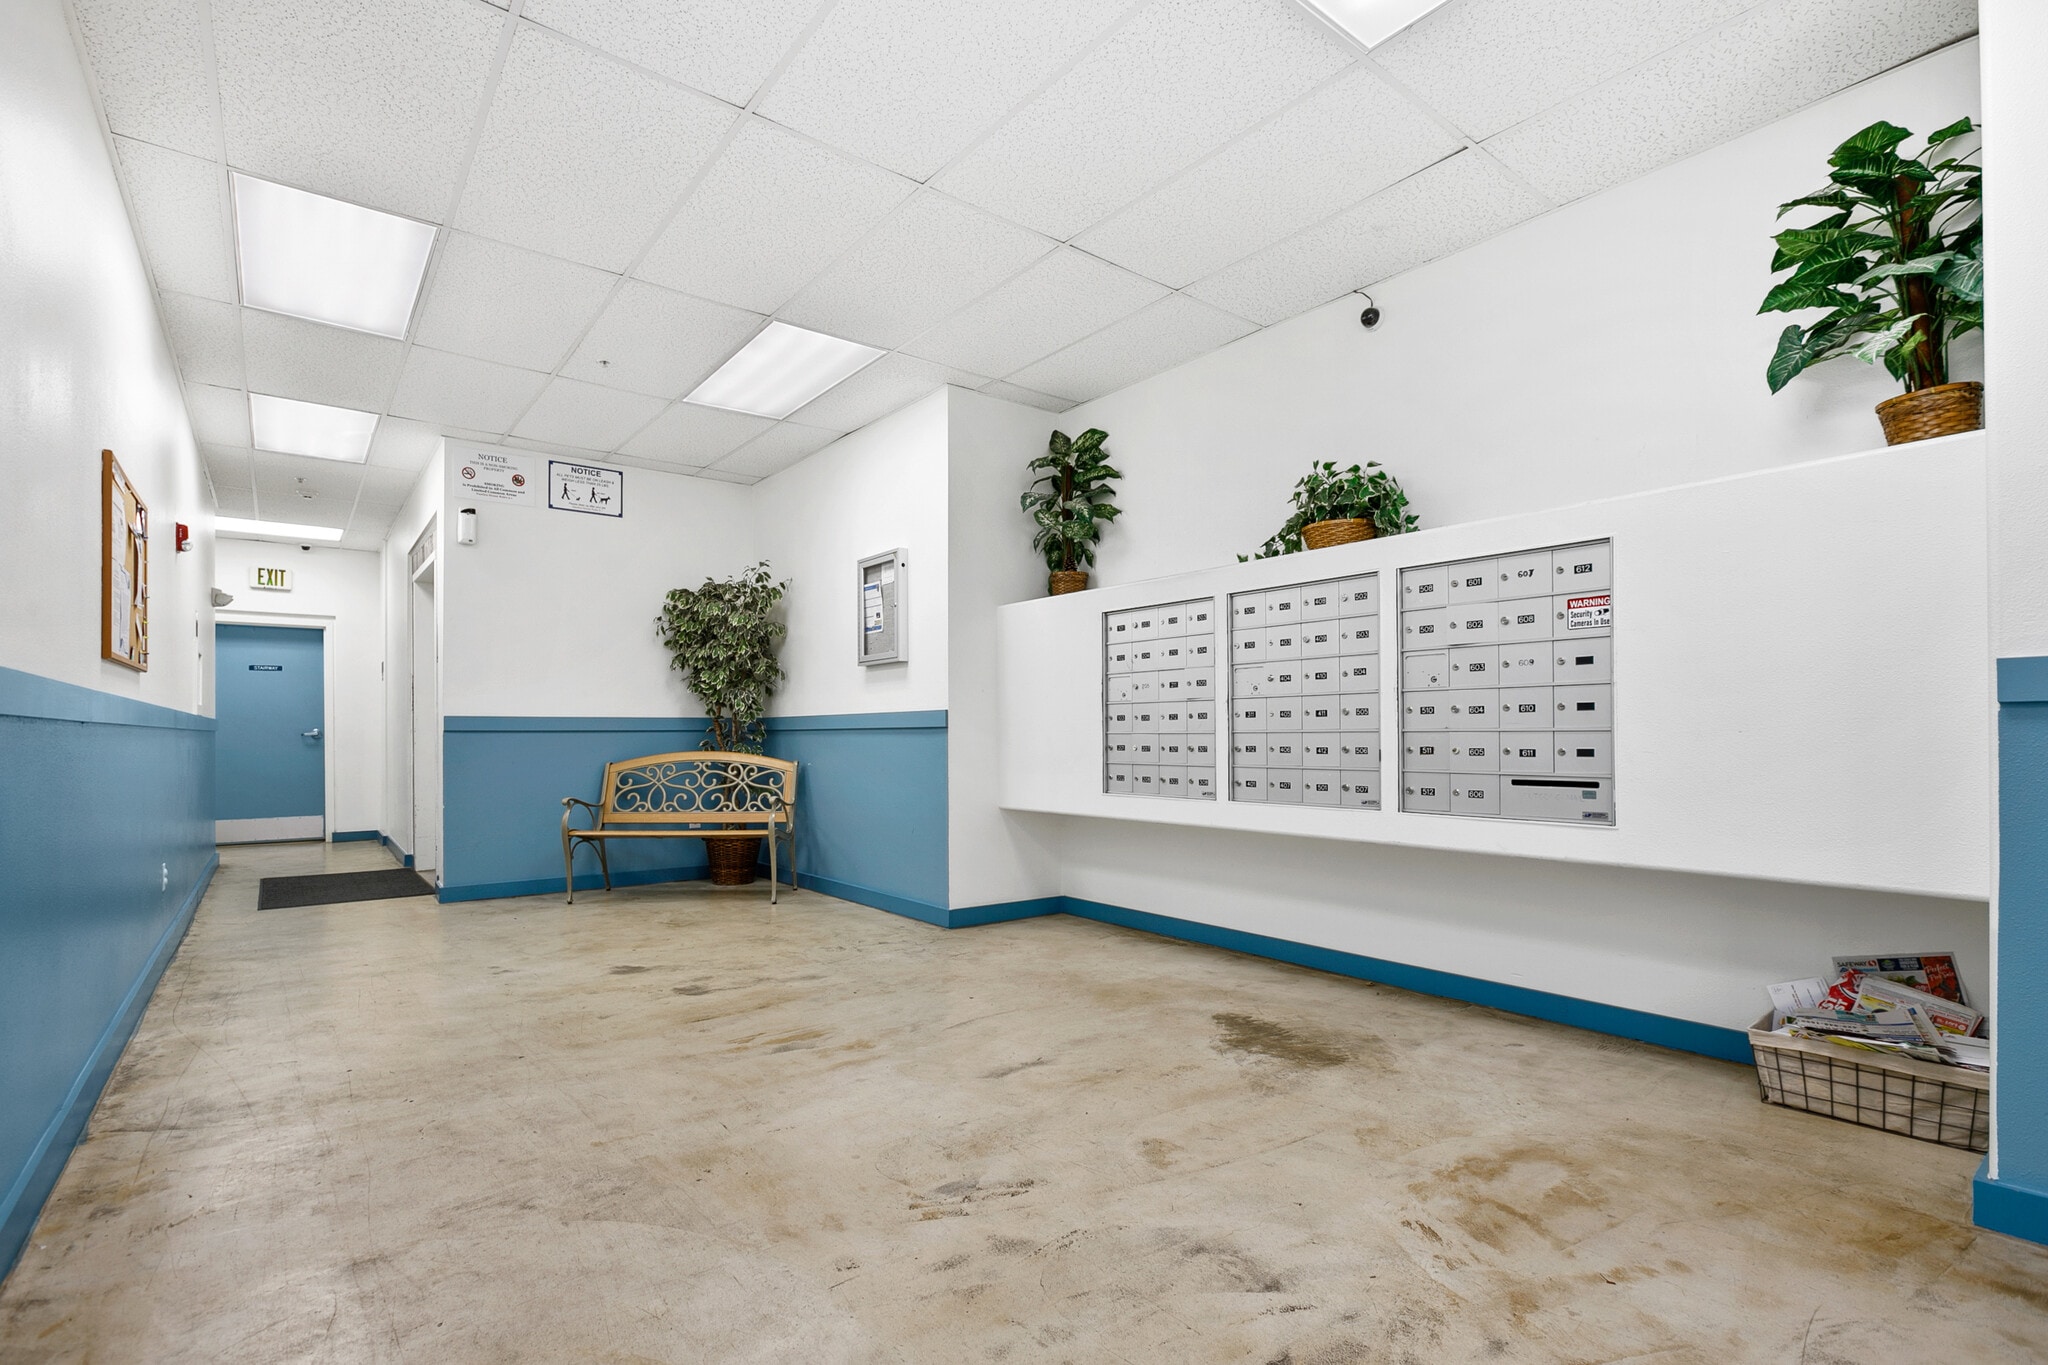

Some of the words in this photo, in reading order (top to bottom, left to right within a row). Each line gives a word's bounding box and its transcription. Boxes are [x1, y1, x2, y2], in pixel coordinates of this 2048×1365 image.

[478, 453, 508, 463] NOTICE
[571, 467, 601, 477] NOTICE
[1518, 569, 1534, 578] 607
[1576, 564, 1590, 574] 612
[258, 568, 286, 586] EXIT
[1468, 577, 1481, 587] 601
[1419, 584, 1433, 593] 508
[1355, 592, 1367, 600] 502
[1569, 597, 1610, 608] WARNING
[1571, 610, 1592, 618] Security
[1518, 615, 1534, 624] 608
[1419, 625, 1434, 633] 509
[1467, 620, 1483, 629] 602
[1356, 630, 1369, 639] 503
[1354, 668, 1366, 676] 504
[1470, 663, 1485, 672] 603
[1469, 706, 1484, 714] 604
[1520, 704, 1534, 713] 610
[1422, 746, 1432, 755] 511
[1469, 748, 1485, 756] 605
[1522, 749, 1534, 757] 611
[1422, 788, 1434, 796] 512
[1468, 790, 1484, 799] 606
